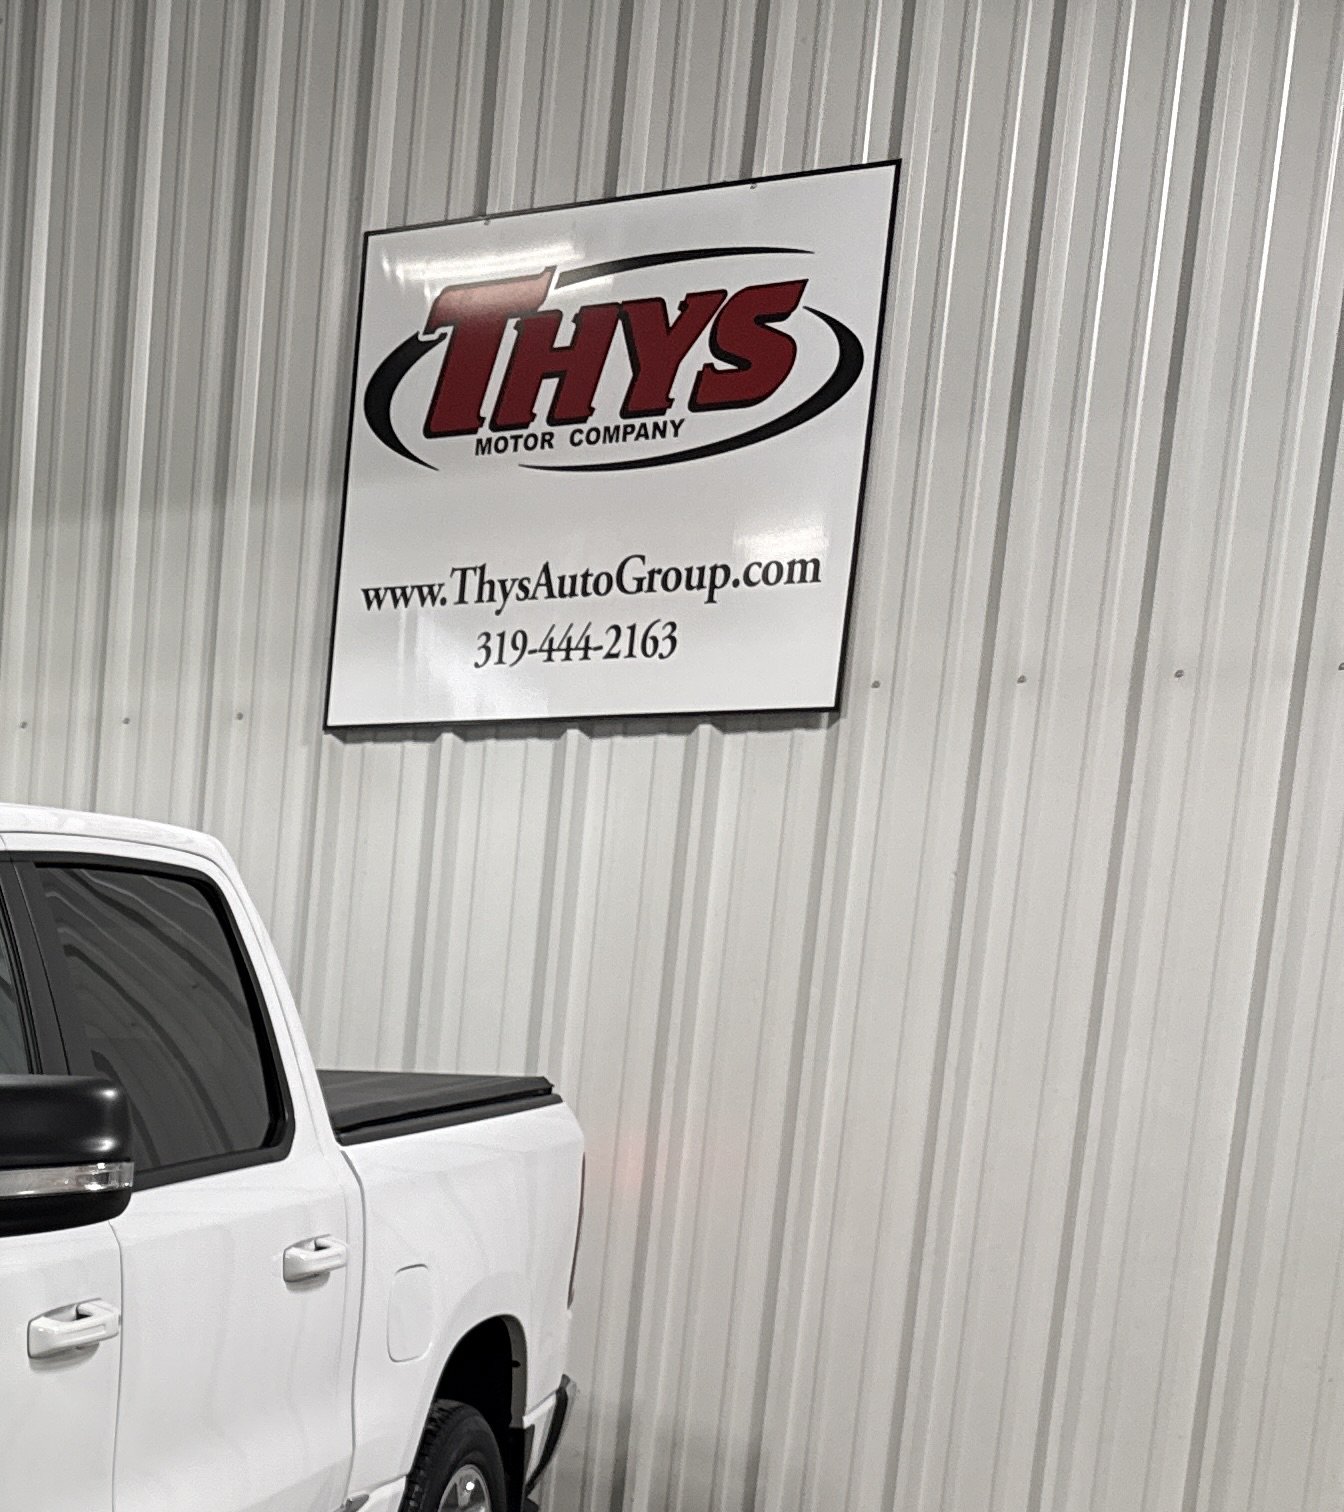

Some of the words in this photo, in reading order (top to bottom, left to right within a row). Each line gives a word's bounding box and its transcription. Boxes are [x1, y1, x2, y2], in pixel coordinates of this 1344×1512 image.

[423, 266, 809, 438] THYS
[474, 430, 555, 456] MOTOR
[569, 418, 685, 447] COMPANY
[361, 553, 822, 616] www.ThysAutoGroup.com
[473, 619, 678, 669] 319-444-2163
